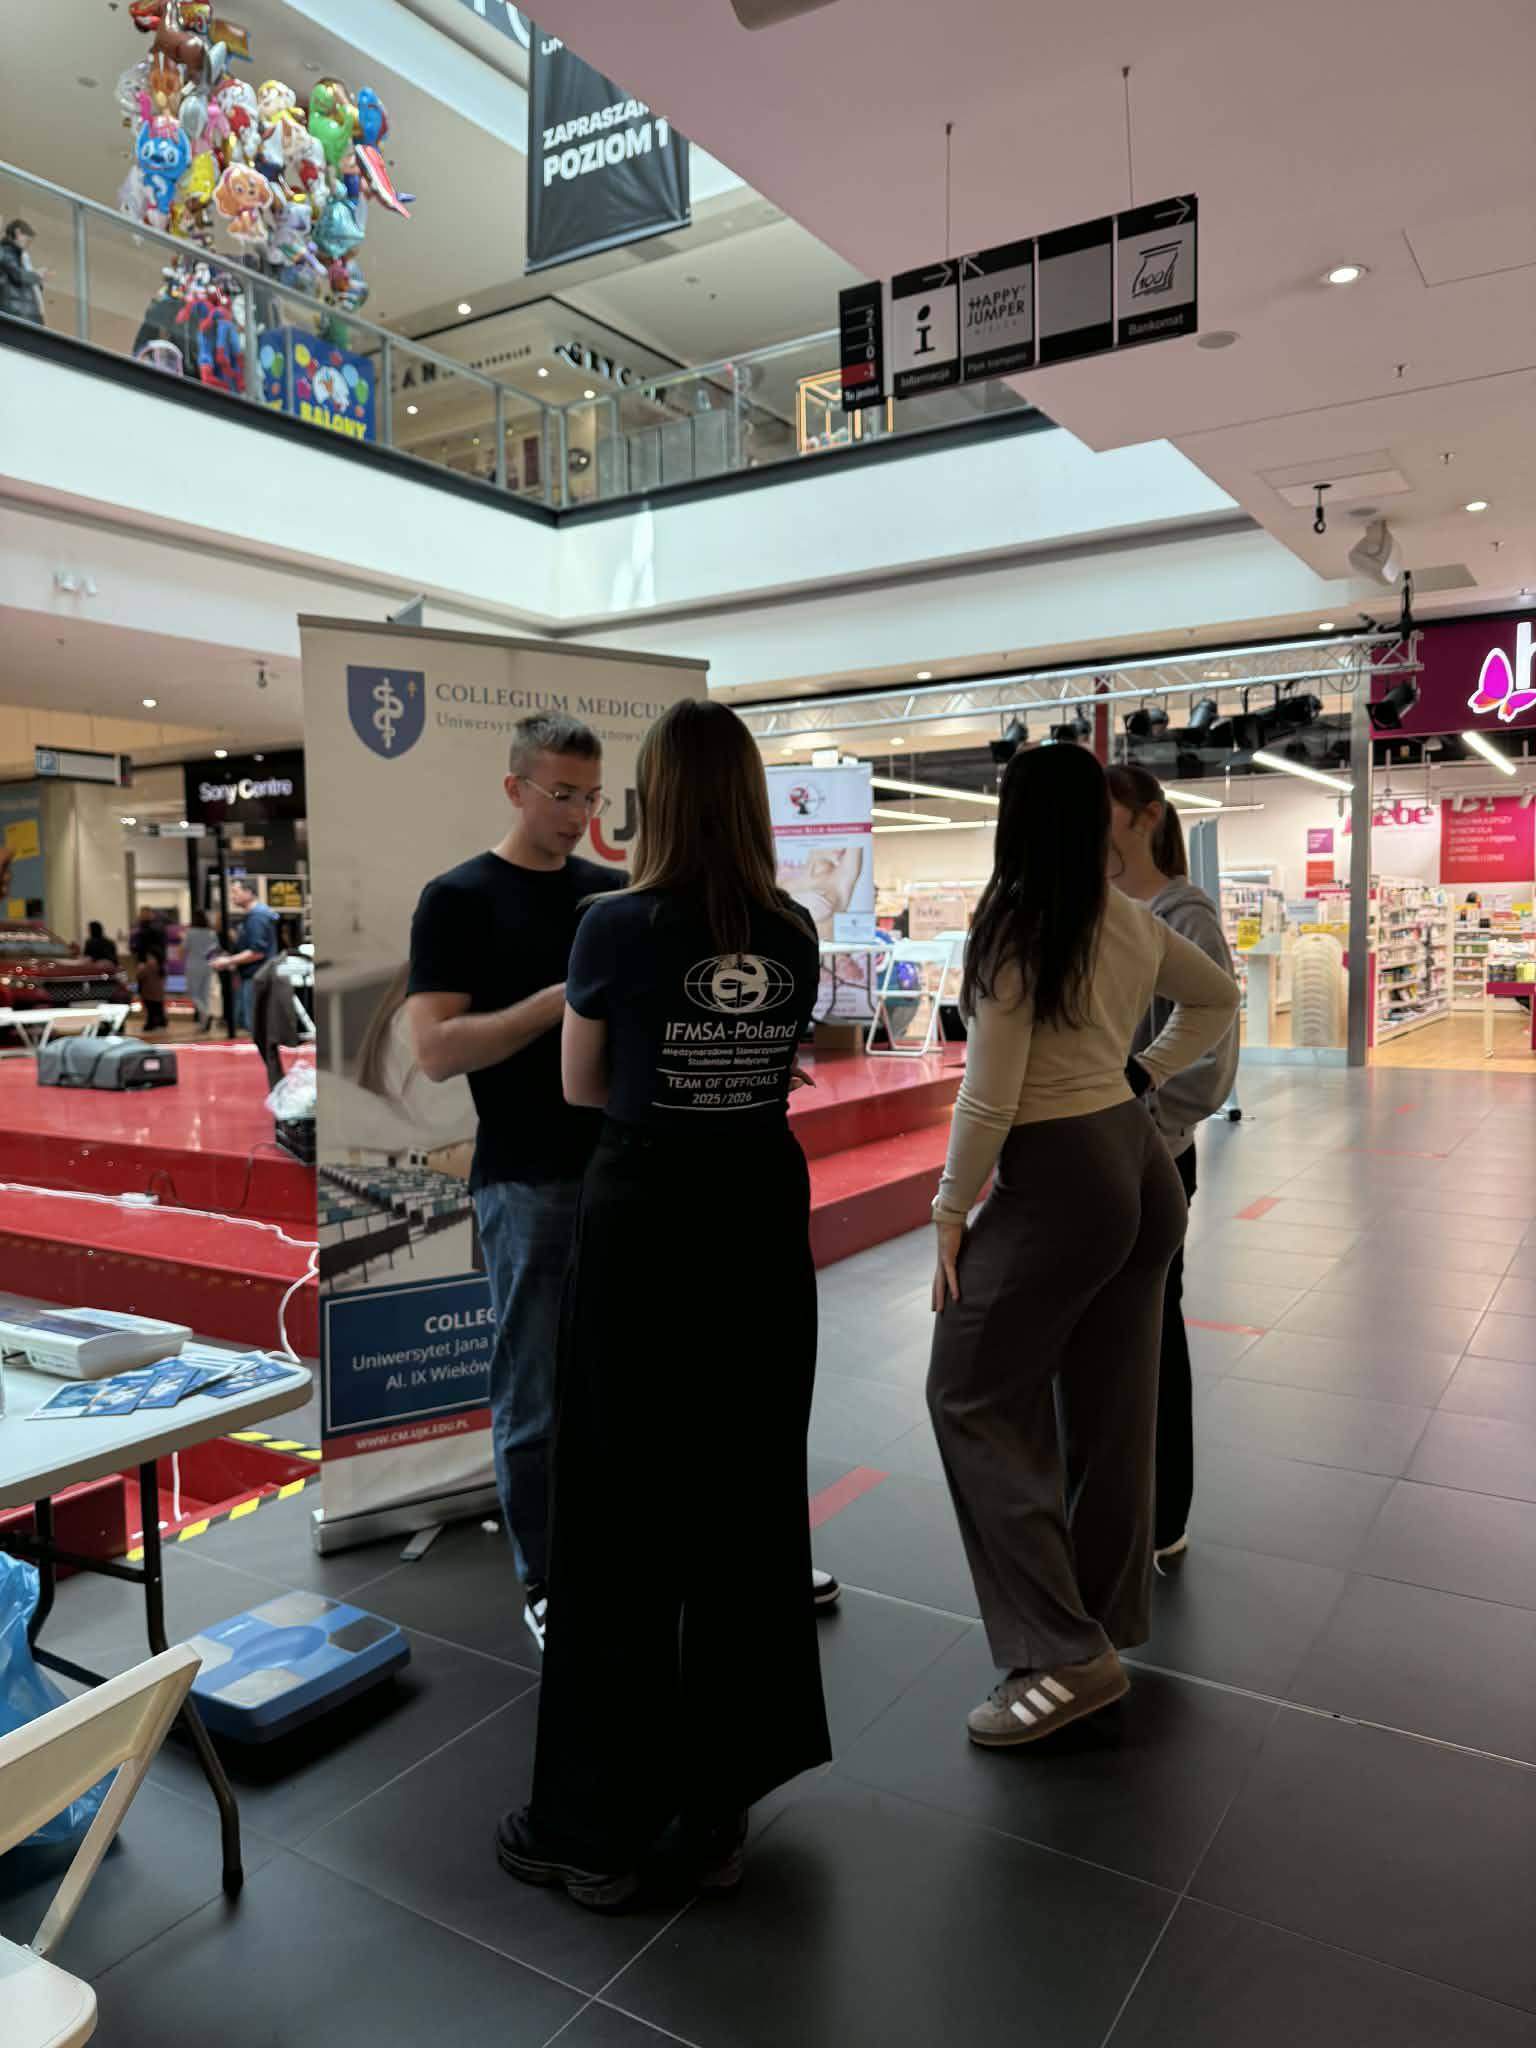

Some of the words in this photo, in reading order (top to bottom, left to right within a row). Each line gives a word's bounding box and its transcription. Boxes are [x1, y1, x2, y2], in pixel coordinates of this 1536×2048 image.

[543, 123, 652, 187] POZIOM
[655, 117, 669, 147] 1
[968, 287, 1019, 311] HAPPY
[967, 300, 1025, 327] JUMPER
[866, 345, 874, 359] 0
[436, 683, 568, 711] COLLEGIUM
[577, 696, 665, 720] MEDICU
[436, 711, 512, 733] Uniwersyt
[200, 782, 237, 805] Sony
[238, 778, 293, 799] Centre
[1371, 800, 1434, 827] ebe
[665, 1020, 798, 1042] IFMSA-Poland
[667, 1075, 702, 1089] TEAM
[705, 1077, 722, 1089] OF
[725, 1072, 779, 1089] OFFICIALS
[692, 1091, 752, 1105] 2025/2026
[424, 1308, 497, 1333] COLLEG
[352, 1341, 451, 1372] Uniwersytet
[454, 1335, 489, 1357] Jana
[386, 1373, 408, 1391] Al.
[411, 1370, 428, 1386] IX
